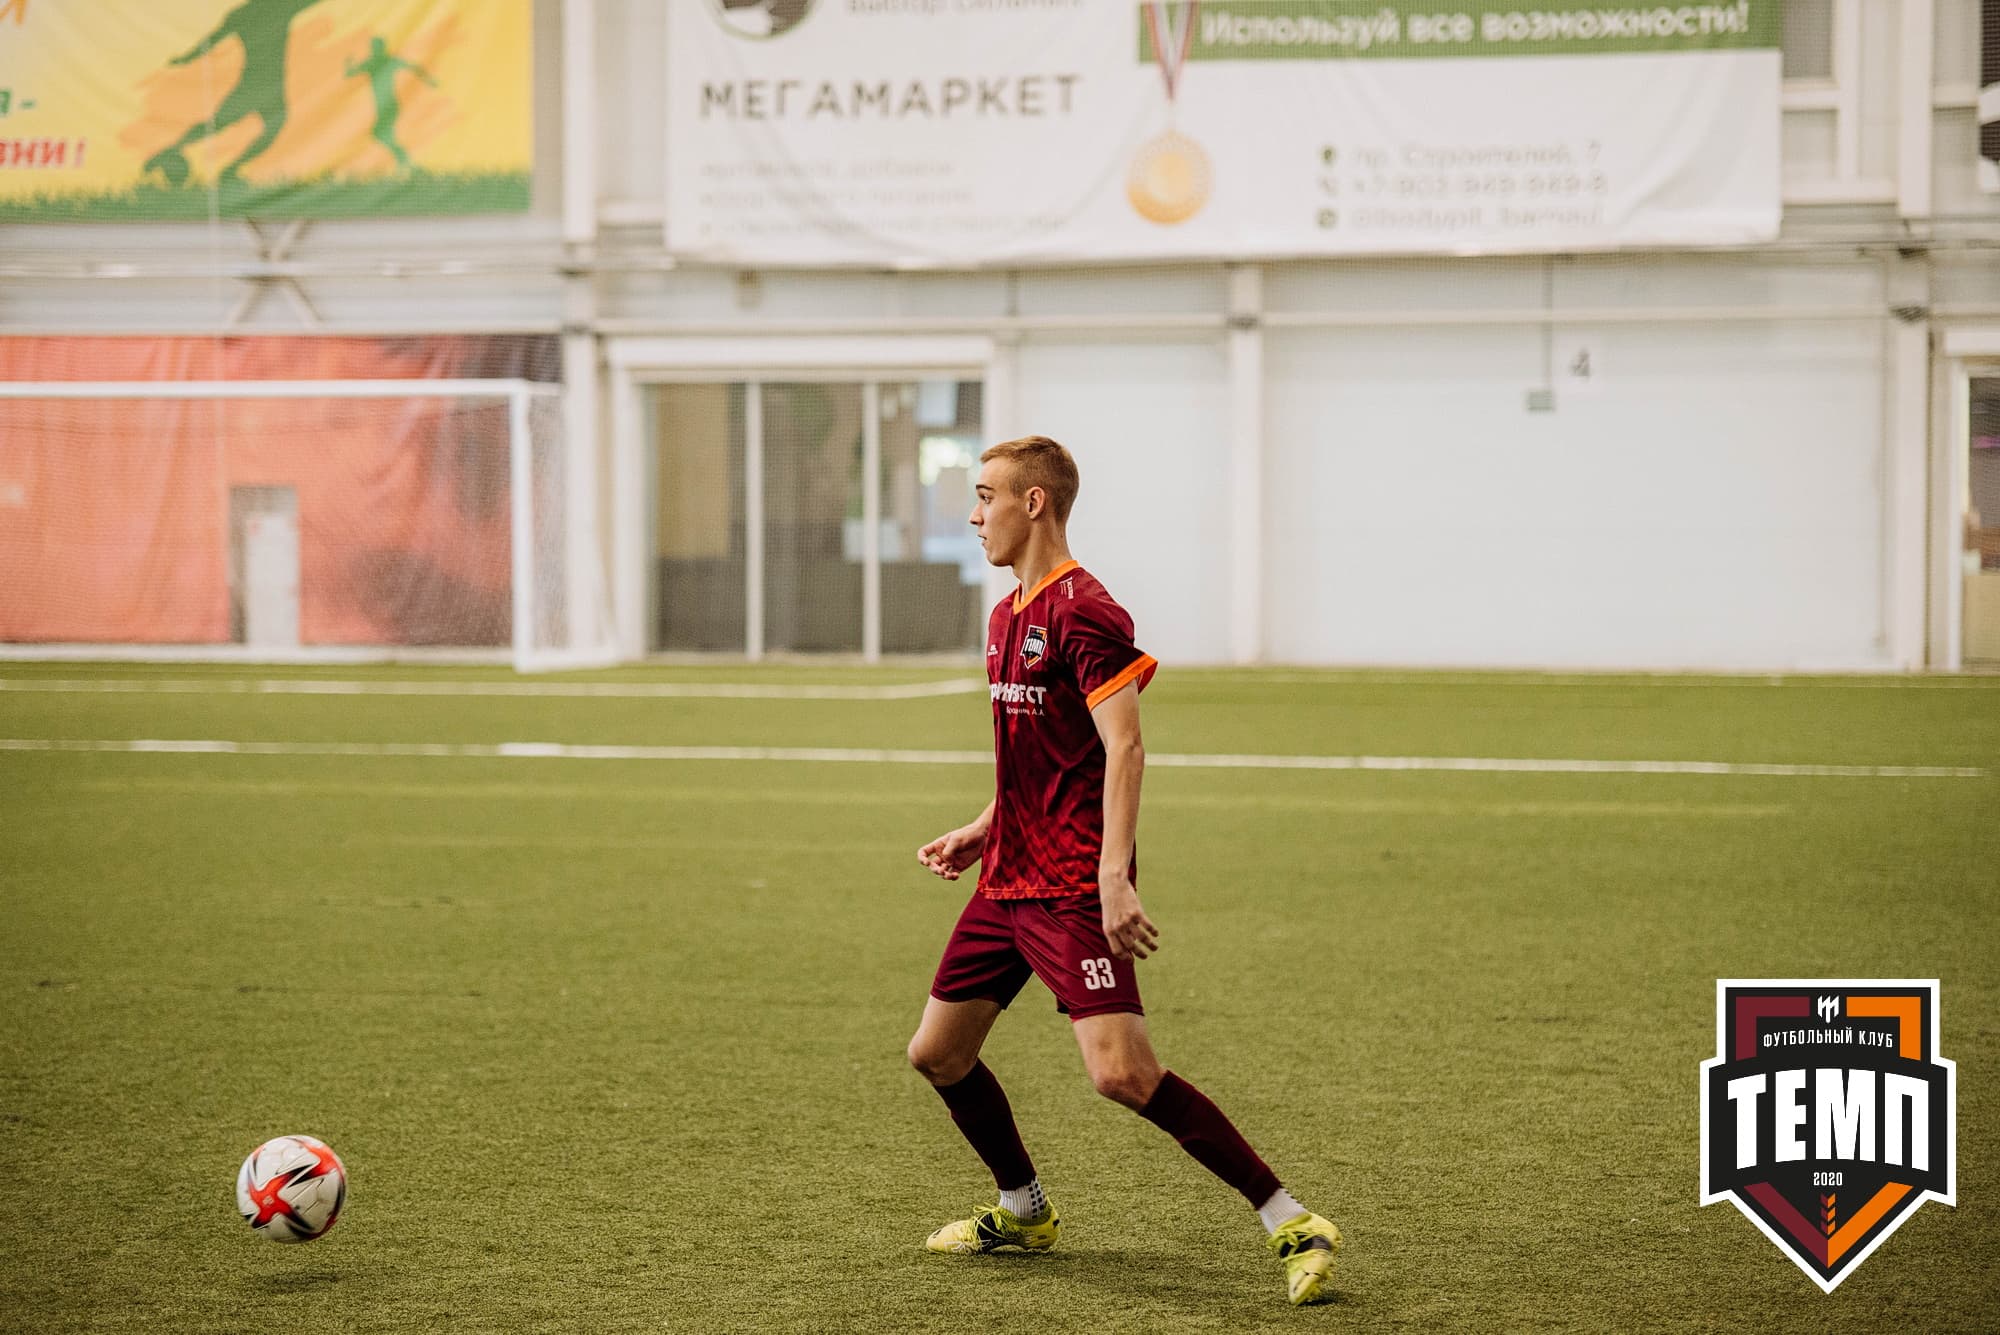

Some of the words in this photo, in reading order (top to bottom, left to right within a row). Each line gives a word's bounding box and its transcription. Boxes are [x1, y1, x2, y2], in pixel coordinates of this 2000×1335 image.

[1203, 8, 1399, 49] Используй
[1408, 14, 1473, 43] все
[1481, 1, 1749, 41] возможности!
[700, 74, 1081, 119] МЕГАМАРКЕТ
[1569, 349, 1592, 382] 4
[1081, 957, 1116, 990] 33
